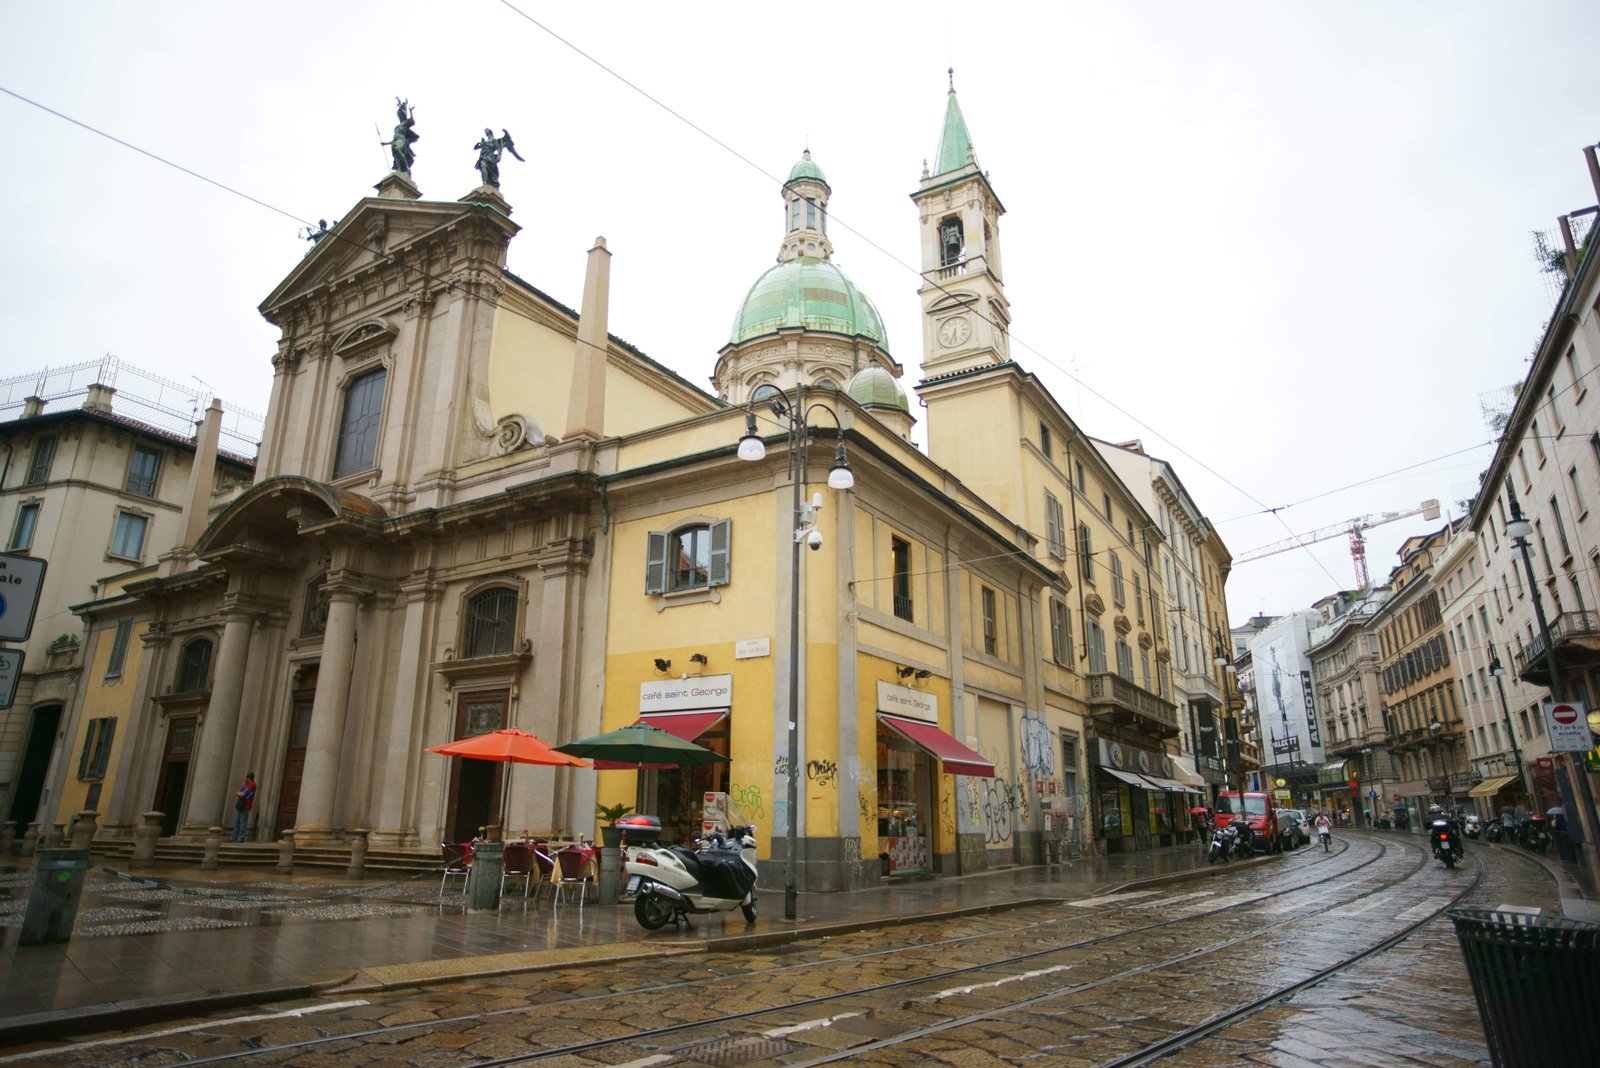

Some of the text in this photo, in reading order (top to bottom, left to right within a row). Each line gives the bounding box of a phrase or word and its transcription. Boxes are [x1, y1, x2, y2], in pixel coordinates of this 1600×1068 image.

[642, 687, 728, 700] café saint George
[1302, 674, 1320, 744] ALCOTT
